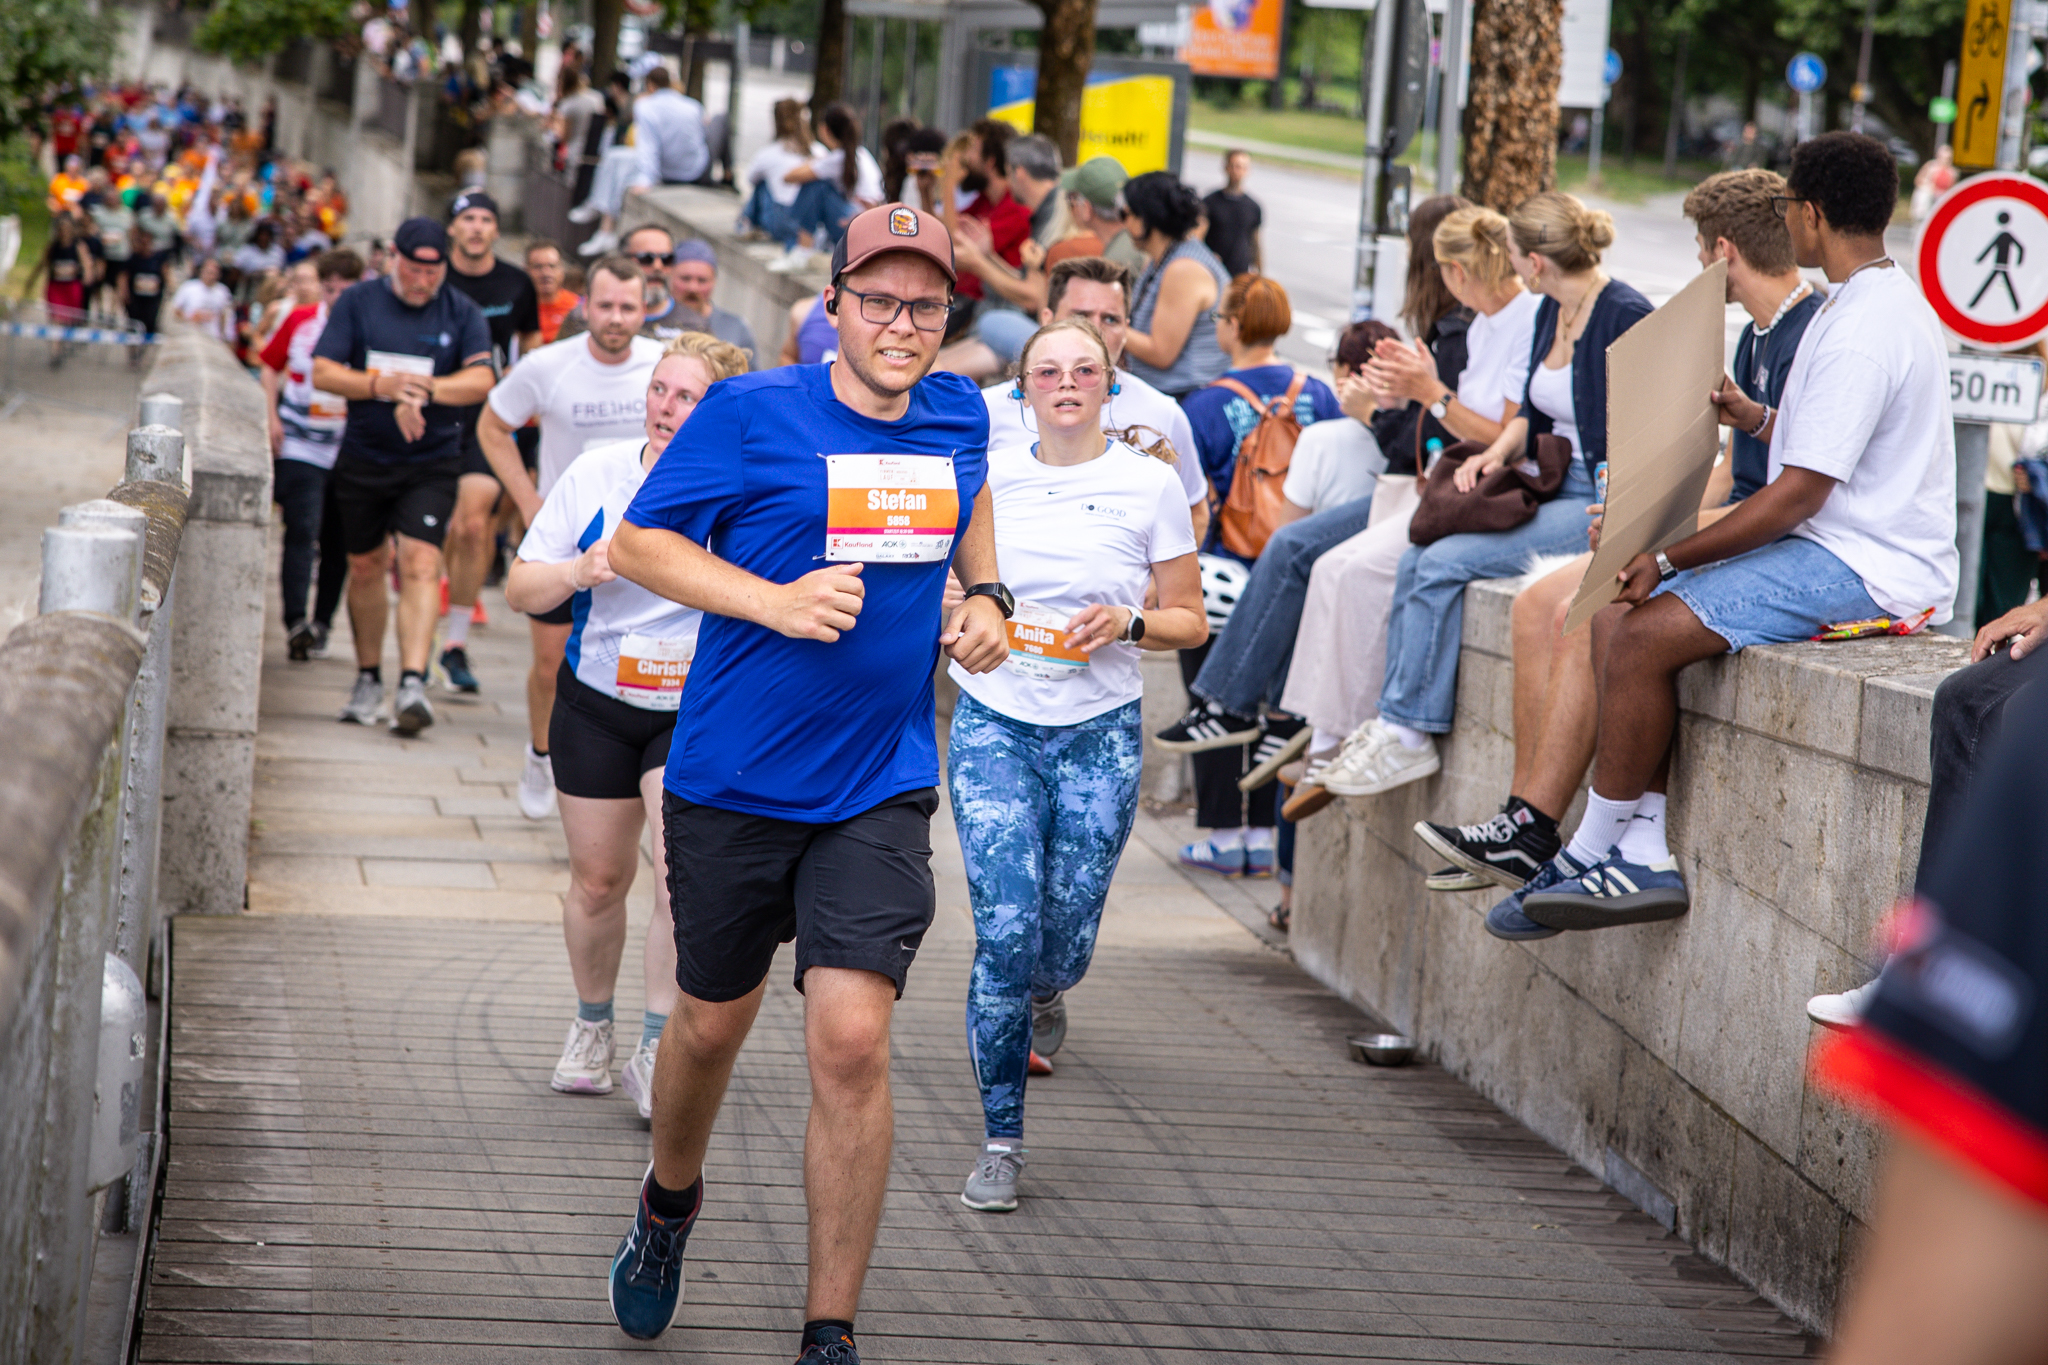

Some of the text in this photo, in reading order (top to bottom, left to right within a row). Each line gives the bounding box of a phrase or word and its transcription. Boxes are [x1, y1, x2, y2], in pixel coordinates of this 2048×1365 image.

[1991, 383, 2021, 404] m
[867, 489, 927, 510] Stefan
[1097, 505, 1126, 517] GOOD
[887, 515, 910, 526] 5858
[881, 540, 898, 548] AOK
[1013, 624, 1055, 645] Anita
